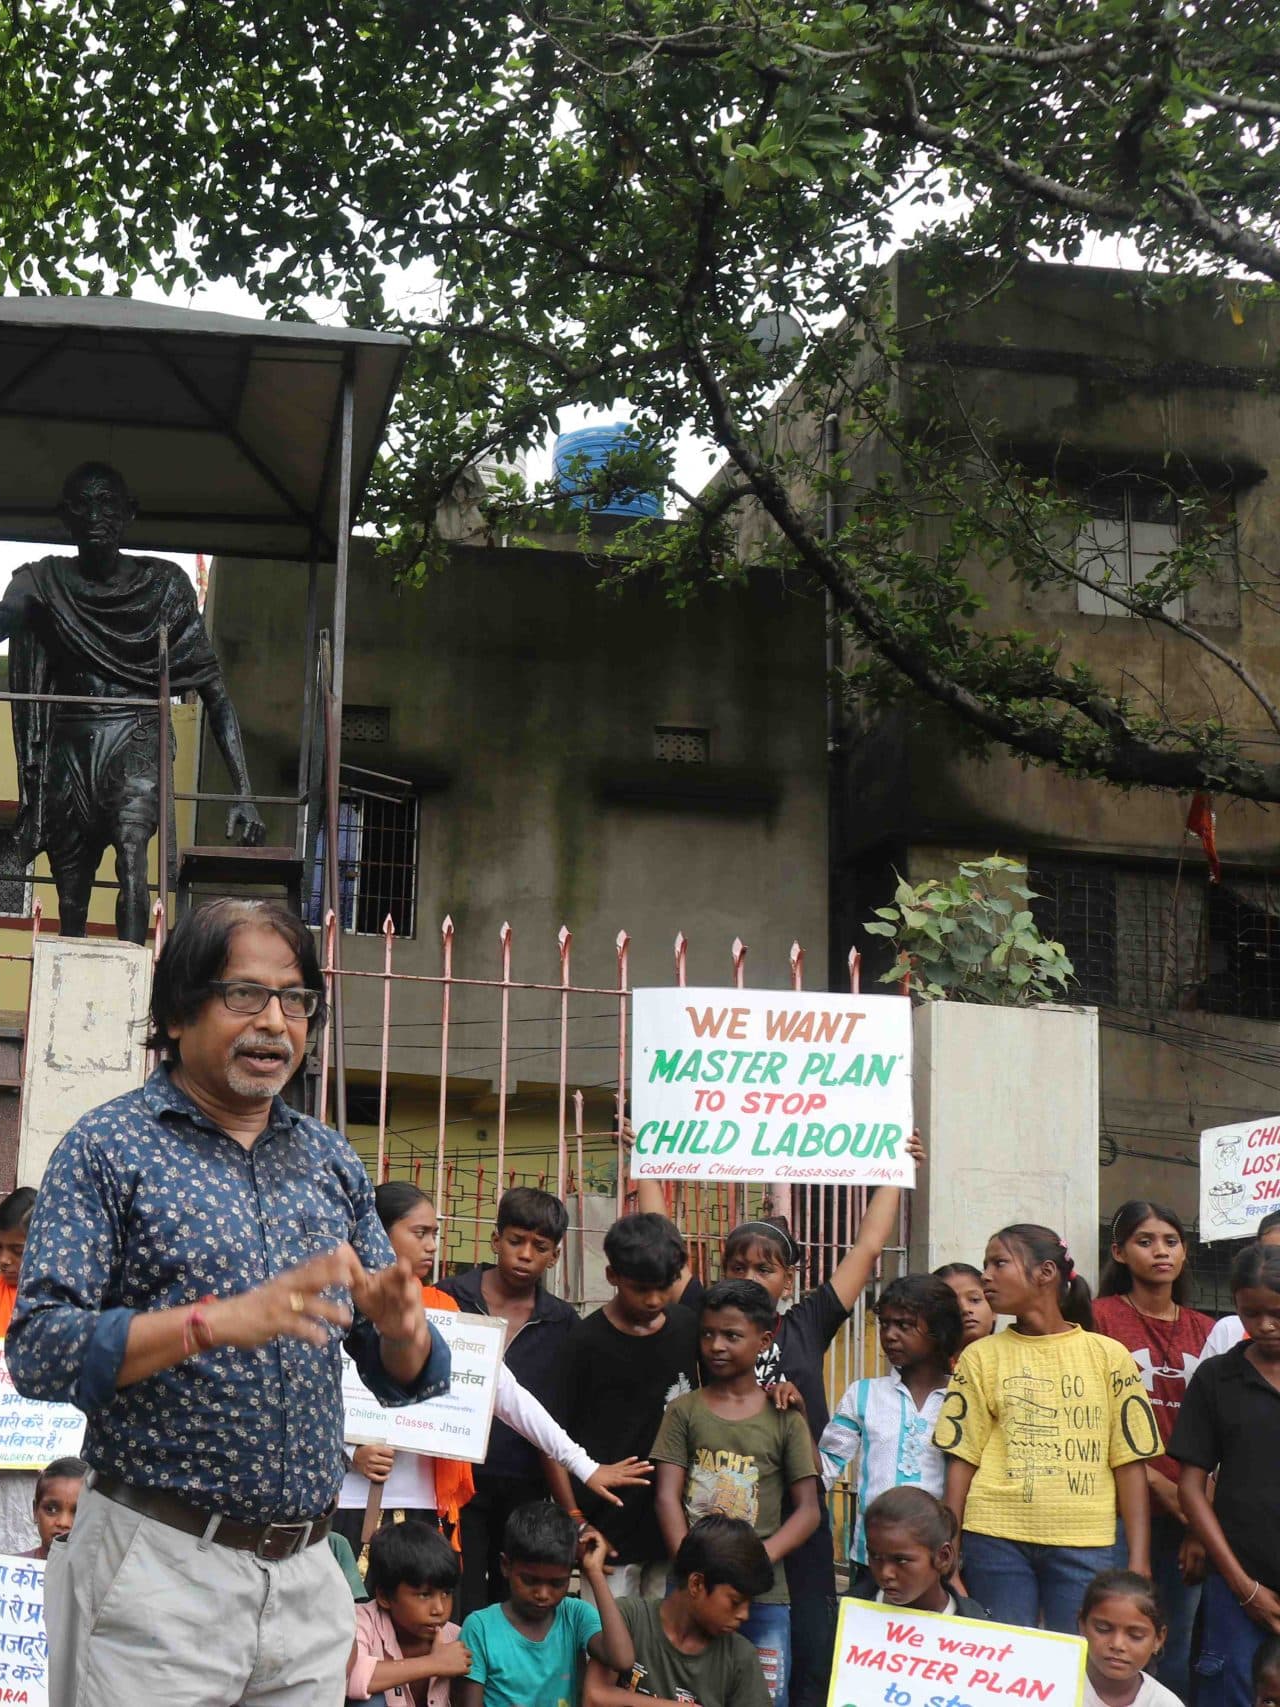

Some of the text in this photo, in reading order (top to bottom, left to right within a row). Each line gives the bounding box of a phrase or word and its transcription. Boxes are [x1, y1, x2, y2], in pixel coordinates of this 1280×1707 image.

[685, 1006, 866, 1044] WE WANT
[694, 1089, 826, 1116] TO STOP
[635, 1119, 902, 1160] CHILD LABOUR
[639, 1161, 699, 1175] Coalfield
[708, 1162, 764, 1176] Children
[1061, 1374, 1085, 1398] GO
[349, 1407, 387, 1420] Children
[439, 1422, 471, 1436] Jharia
[1063, 1406, 1102, 1430] YOUR
[696, 1448, 756, 1474] YACHT
[1065, 1438, 1101, 1463] OWN
[1066, 1471, 1096, 1496] WAY
[886, 1621, 1015, 1662] We want
[846, 1645, 1056, 1702] MASTER PLAN
[883, 1682, 912, 1706] to
